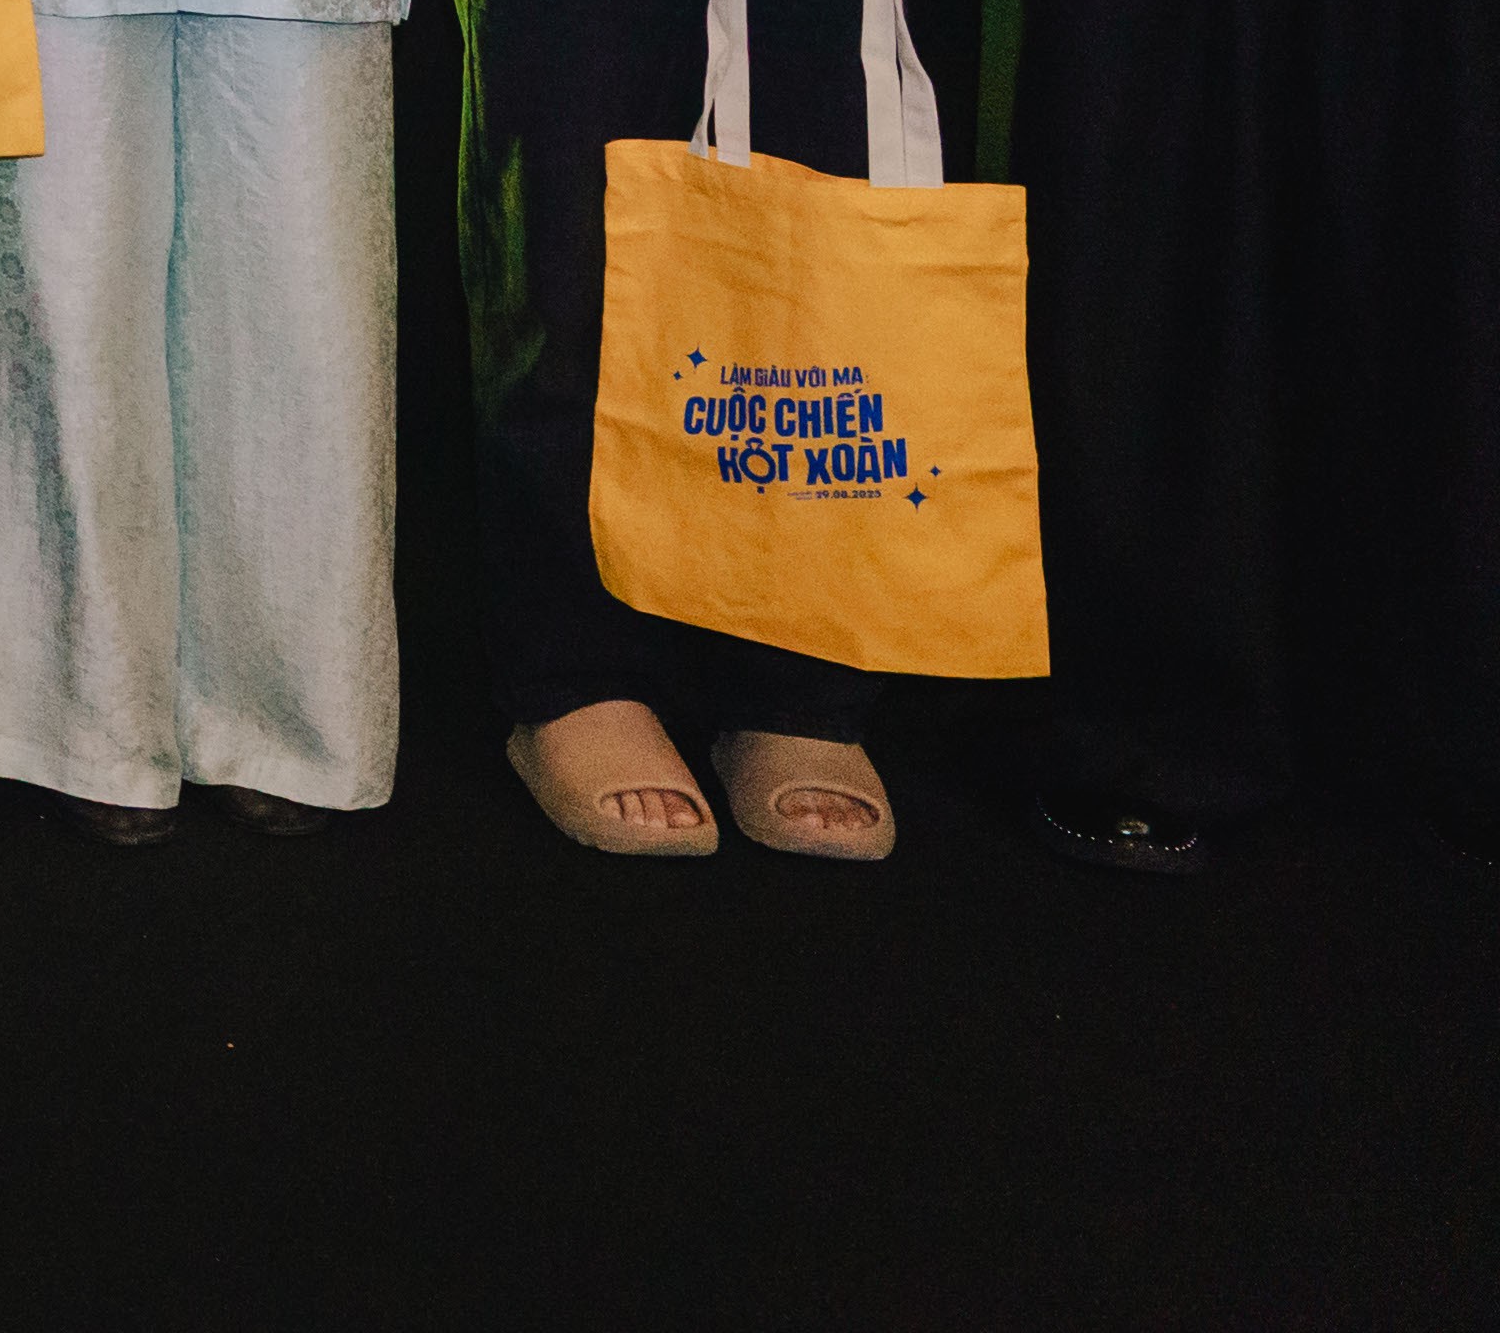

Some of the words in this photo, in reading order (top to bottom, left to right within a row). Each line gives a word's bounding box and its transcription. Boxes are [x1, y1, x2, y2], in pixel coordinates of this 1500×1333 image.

[720, 362, 752, 386] LÀM
[683, 386, 766, 441] CUỘC
[774, 389, 884, 439] CHIẾN
[804, 436, 908, 485] XOÀN
